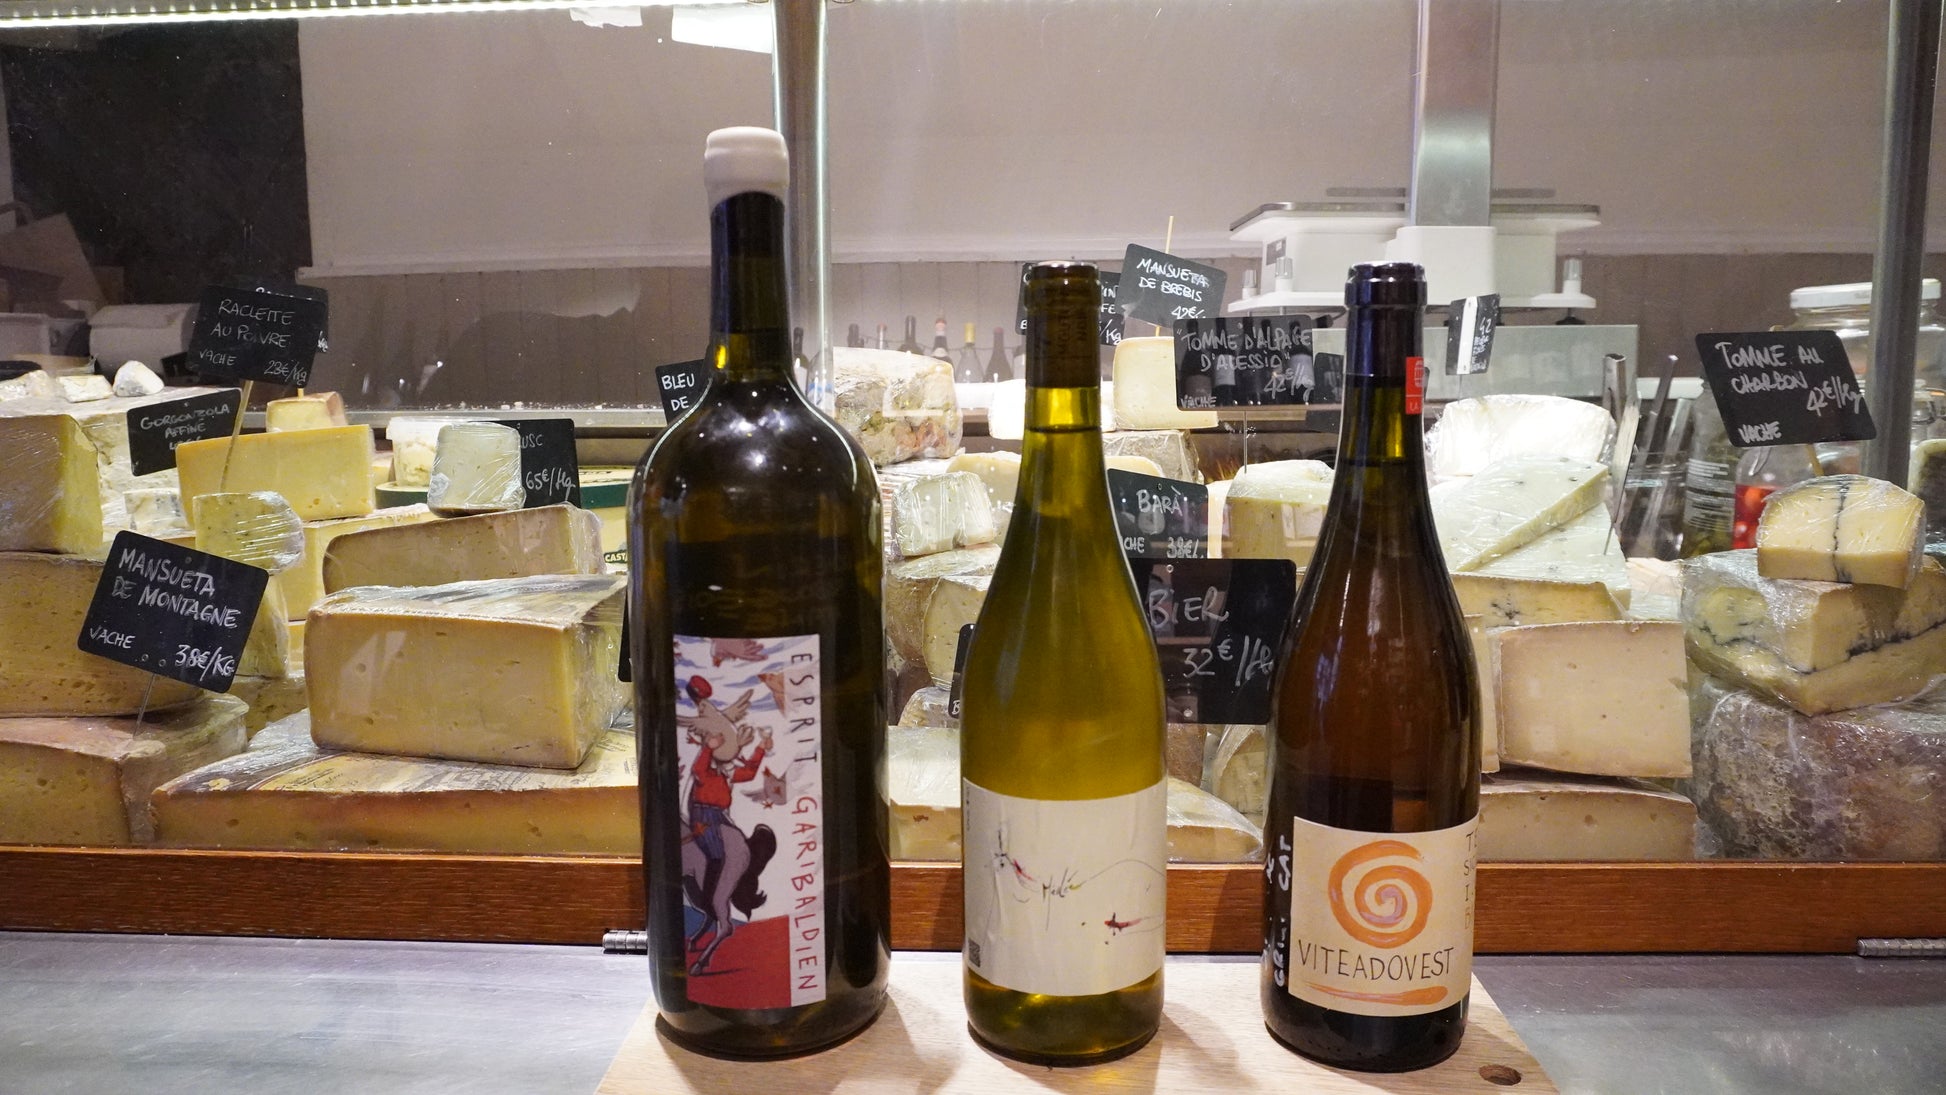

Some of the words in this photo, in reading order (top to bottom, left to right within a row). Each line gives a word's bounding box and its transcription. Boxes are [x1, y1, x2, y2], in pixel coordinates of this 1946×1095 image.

[1138, 276, 1158, 290] DE
[1160, 280, 1203, 302] BREBIS
[218, 299, 296, 326] RACLETTE
[210, 322, 233, 337] AU
[199, 349, 238, 367] VACHE
[1715, 341, 1787, 369] TOMME
[1797, 345, 1825, 365] AU
[661, 373, 696, 391] BLEU
[1731, 370, 1809, 395] CHARBON
[670, 395, 690, 412] DE
[1180, 395, 1217, 409] VACHE
[140, 403, 231, 431] GORGONZOLA
[1737, 420, 1783, 444] VACHE
[118, 547, 216, 598] MANSUETA
[111, 575, 137, 600] DE
[137, 585, 242, 629] MONTAGNE
[89, 626, 136, 650] VACHE
[789, 652, 818, 764] ESPRIT
[790, 796, 821, 991] GARIBALDIEN
[1298, 939, 1455, 982] VITEADOVEST
